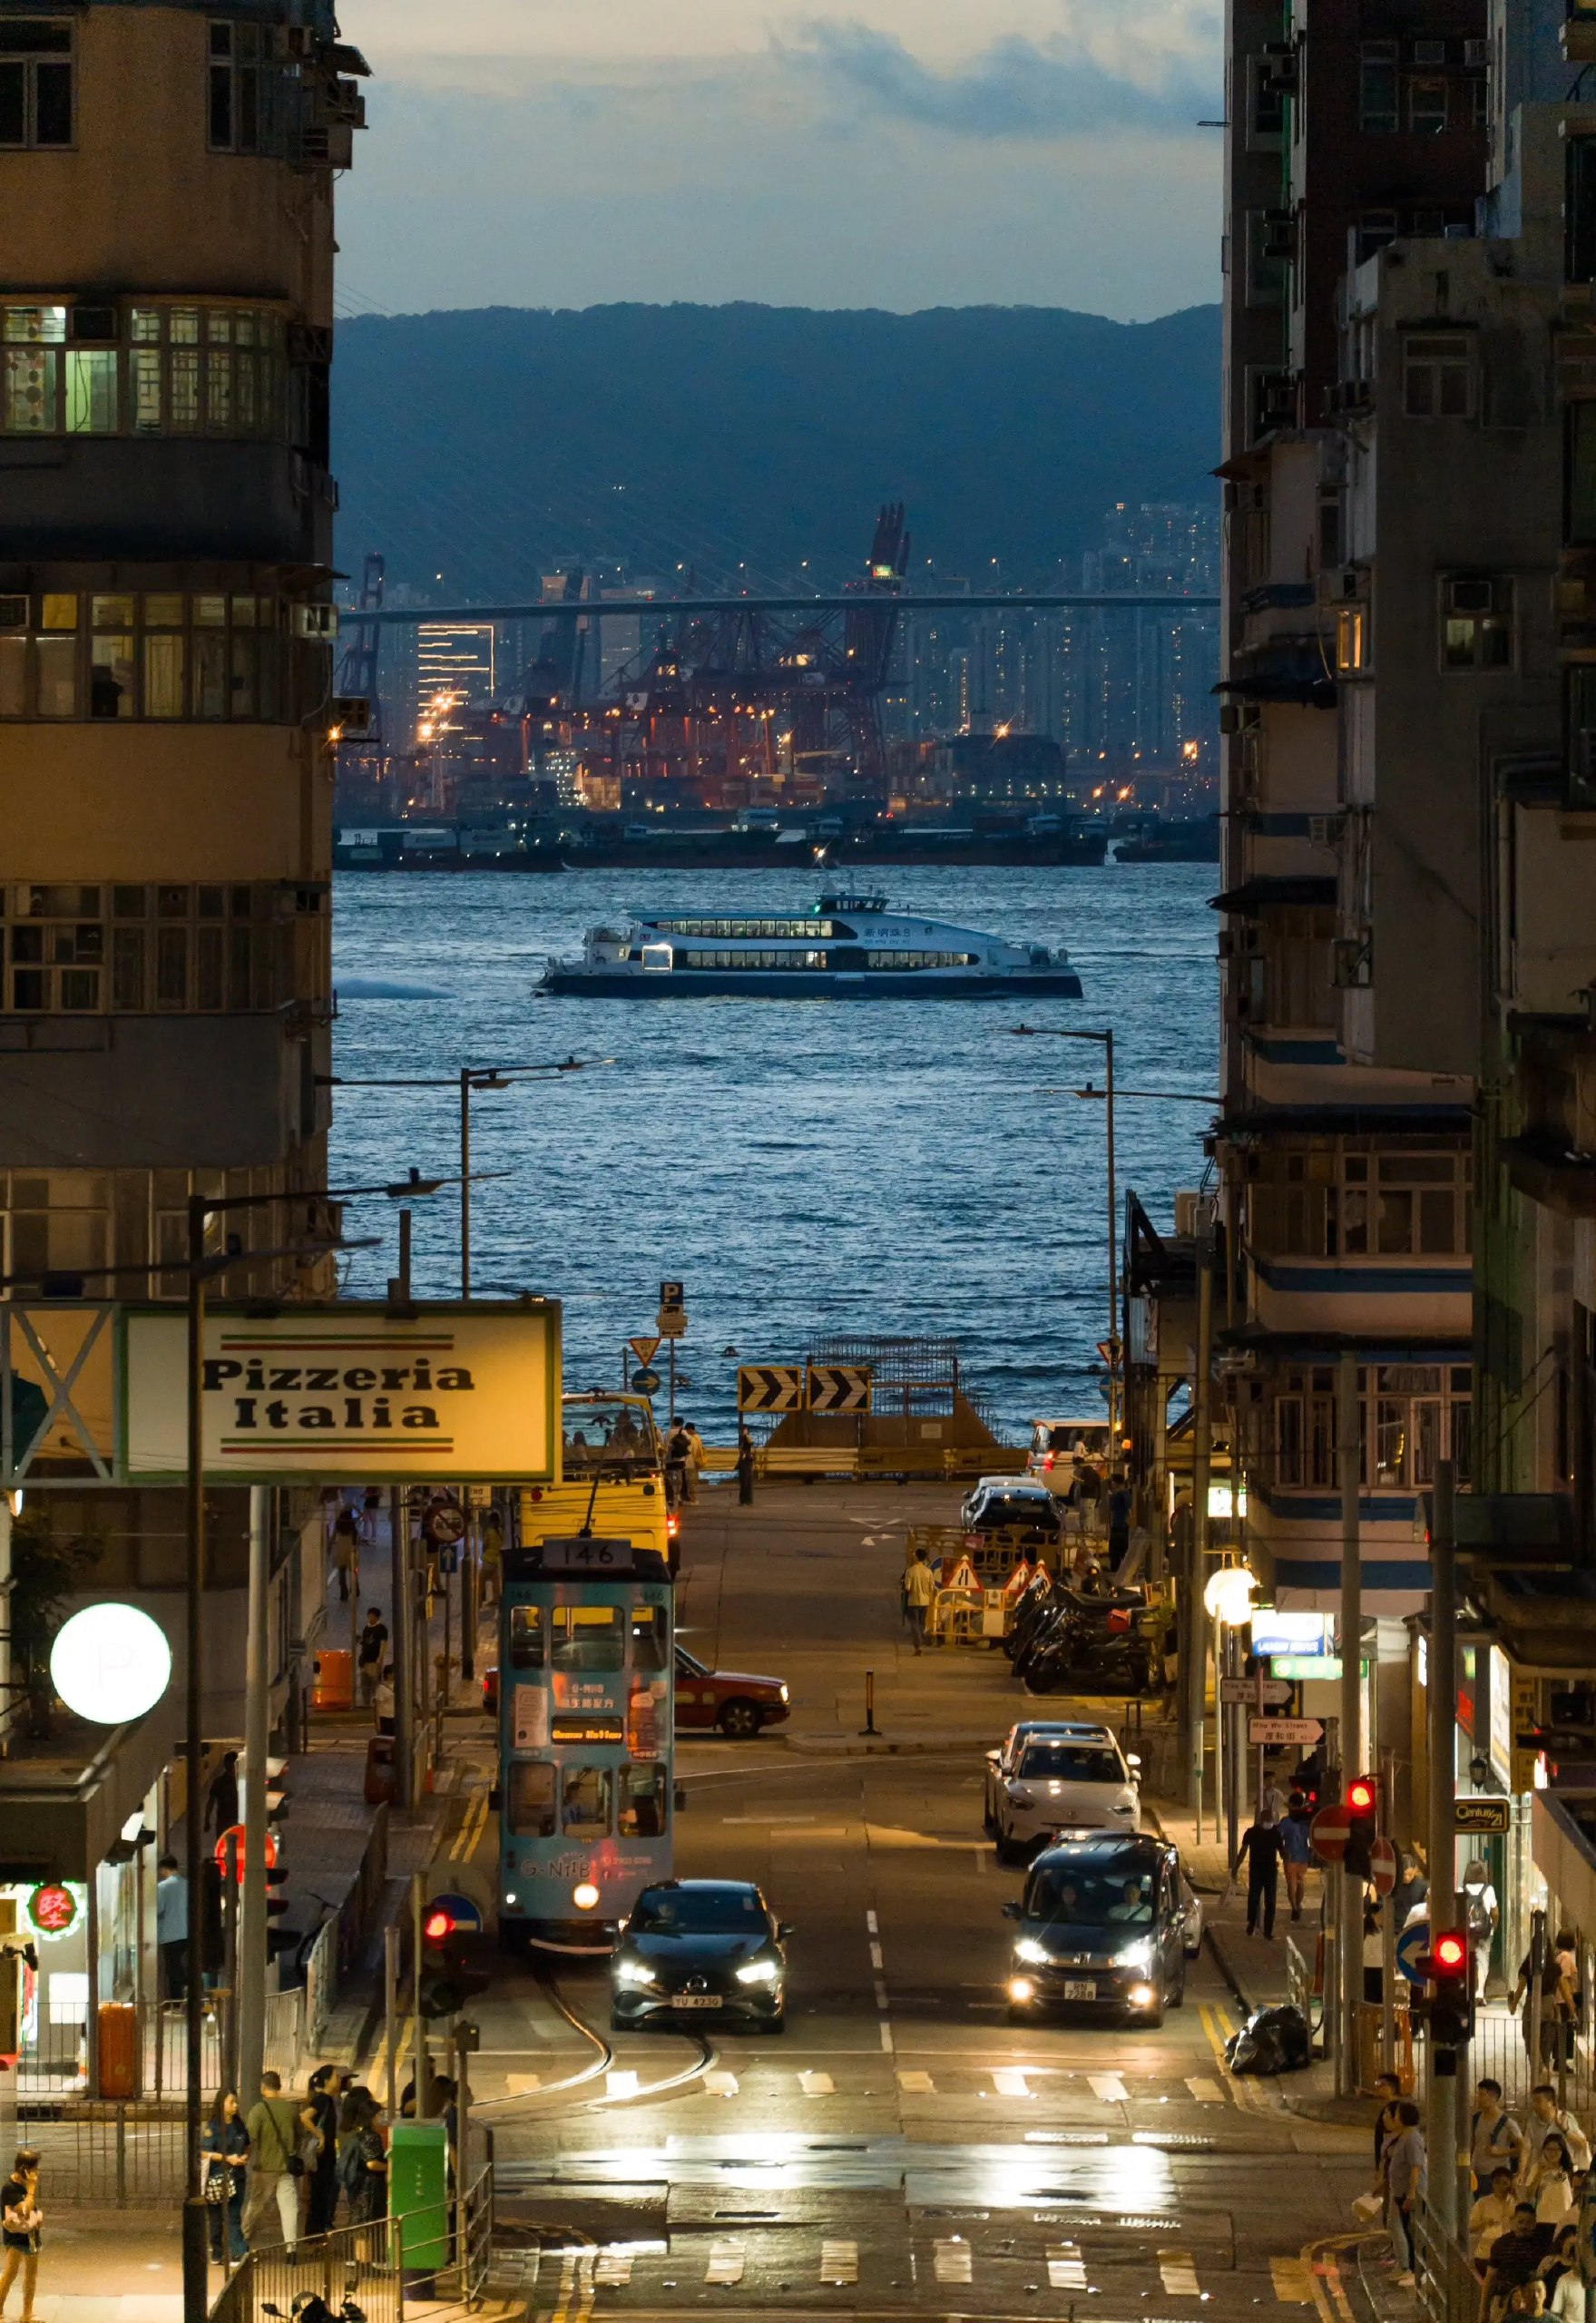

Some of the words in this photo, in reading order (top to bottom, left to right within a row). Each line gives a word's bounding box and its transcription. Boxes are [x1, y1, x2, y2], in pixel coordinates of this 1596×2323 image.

[663, 1283, 679, 1303] P
[202, 1358, 475, 1390] Pizzeria
[235, 1397, 440, 1428] Italia
[563, 1544, 615, 1564] 146
[643, 1590, 664, 1601] 146
[1286, 1721, 1307, 1730] Street
[1456, 1806, 1495, 1819] Century
[1491, 1813, 1503, 1827] 21
